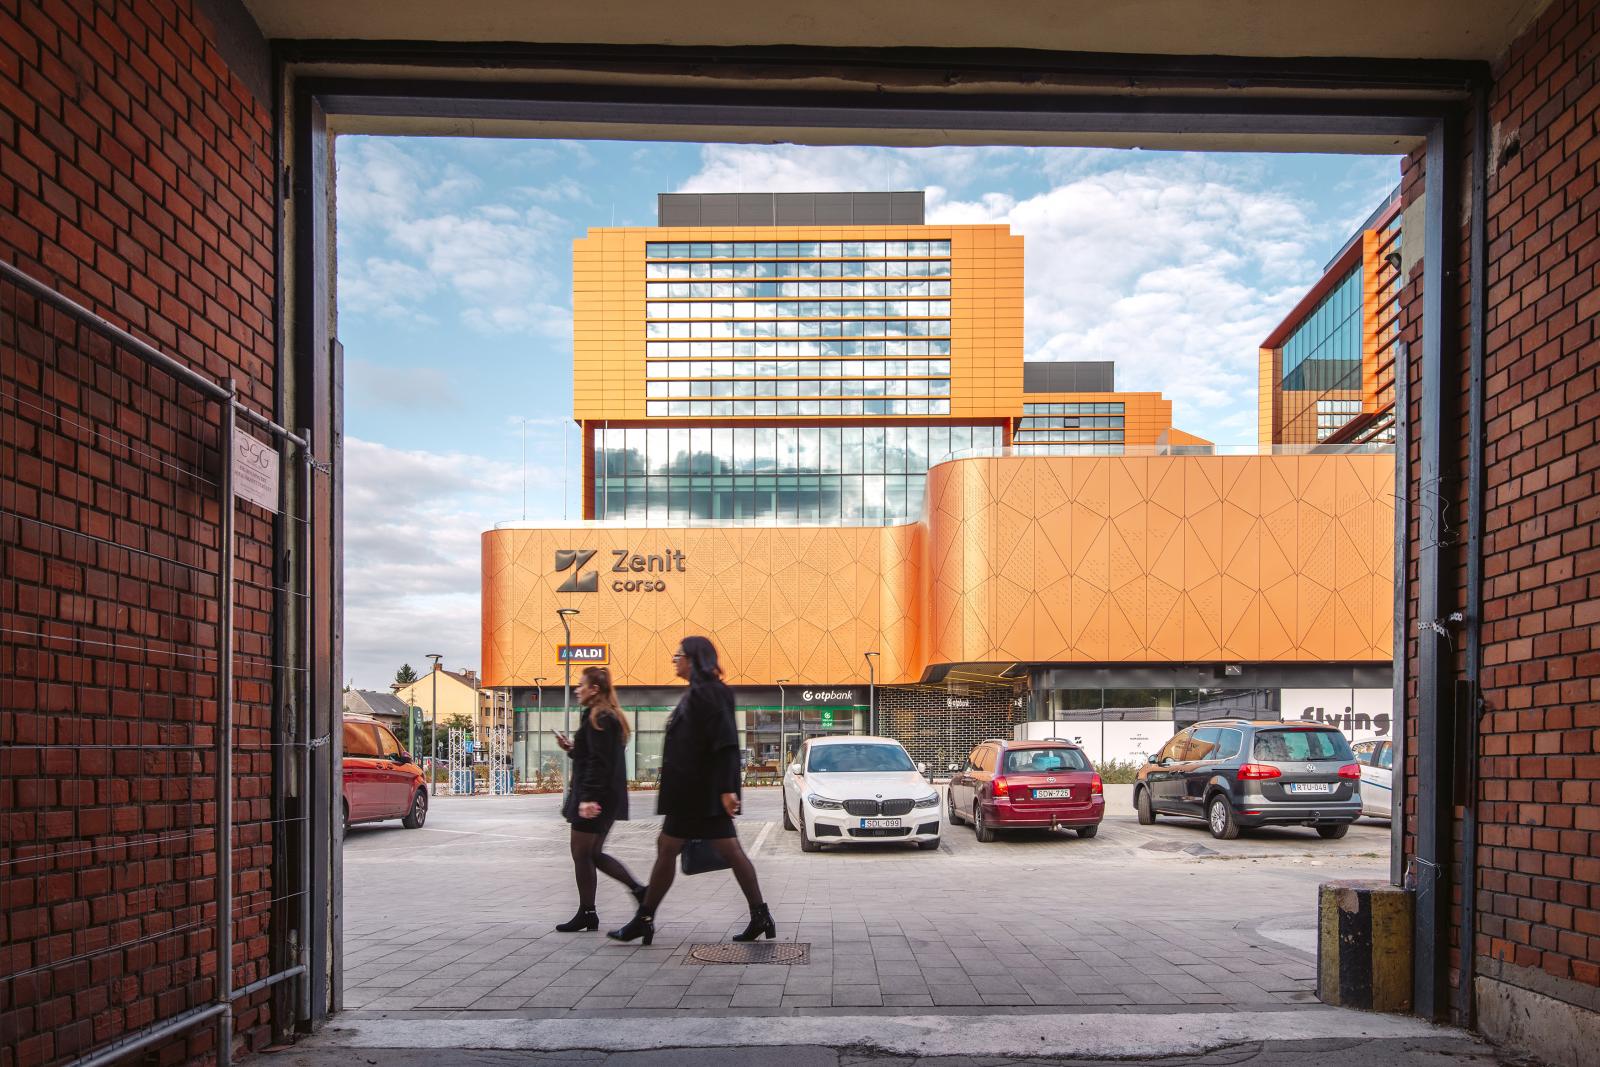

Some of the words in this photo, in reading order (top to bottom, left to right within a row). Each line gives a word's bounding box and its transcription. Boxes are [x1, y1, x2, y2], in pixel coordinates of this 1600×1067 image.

[611, 549, 686, 572] Zenit
[611, 579, 666, 592] corso
[574, 648, 602, 658] ALDI
[814, 690, 853, 702] otpbank
[1300, 706, 1390, 737] flying
